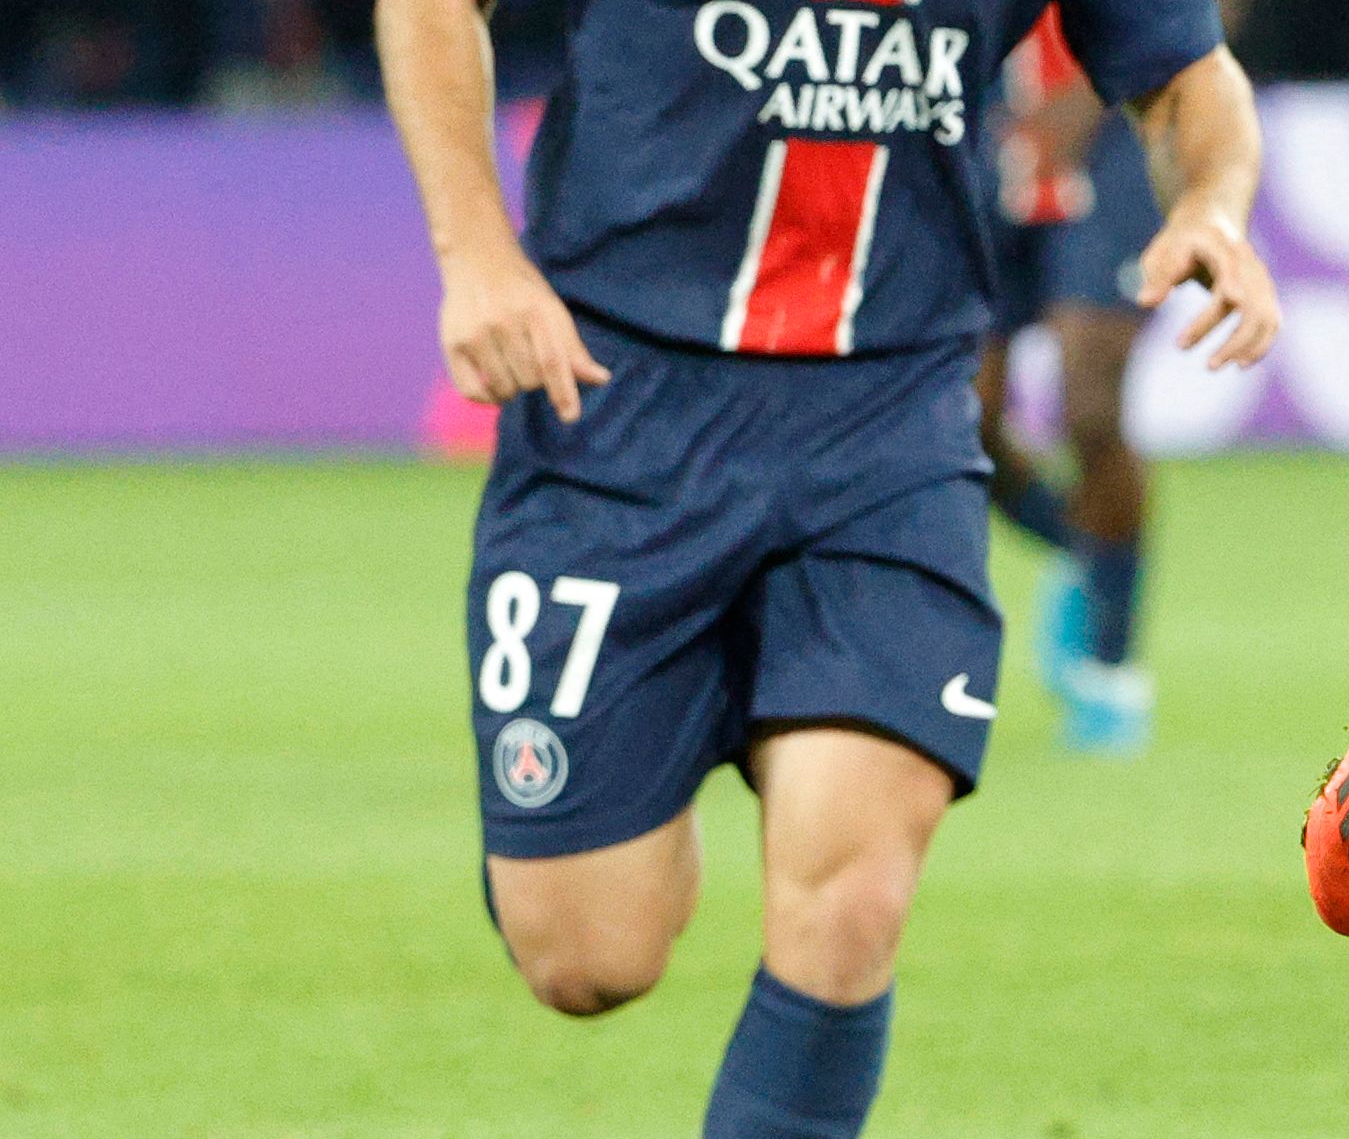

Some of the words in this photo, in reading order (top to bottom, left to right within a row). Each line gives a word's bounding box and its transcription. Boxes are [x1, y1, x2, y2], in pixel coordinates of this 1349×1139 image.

[693, 0, 970, 98] QATAR
[756, 81, 965, 146] AIRWAYS
[478, 570, 621, 718] 87
